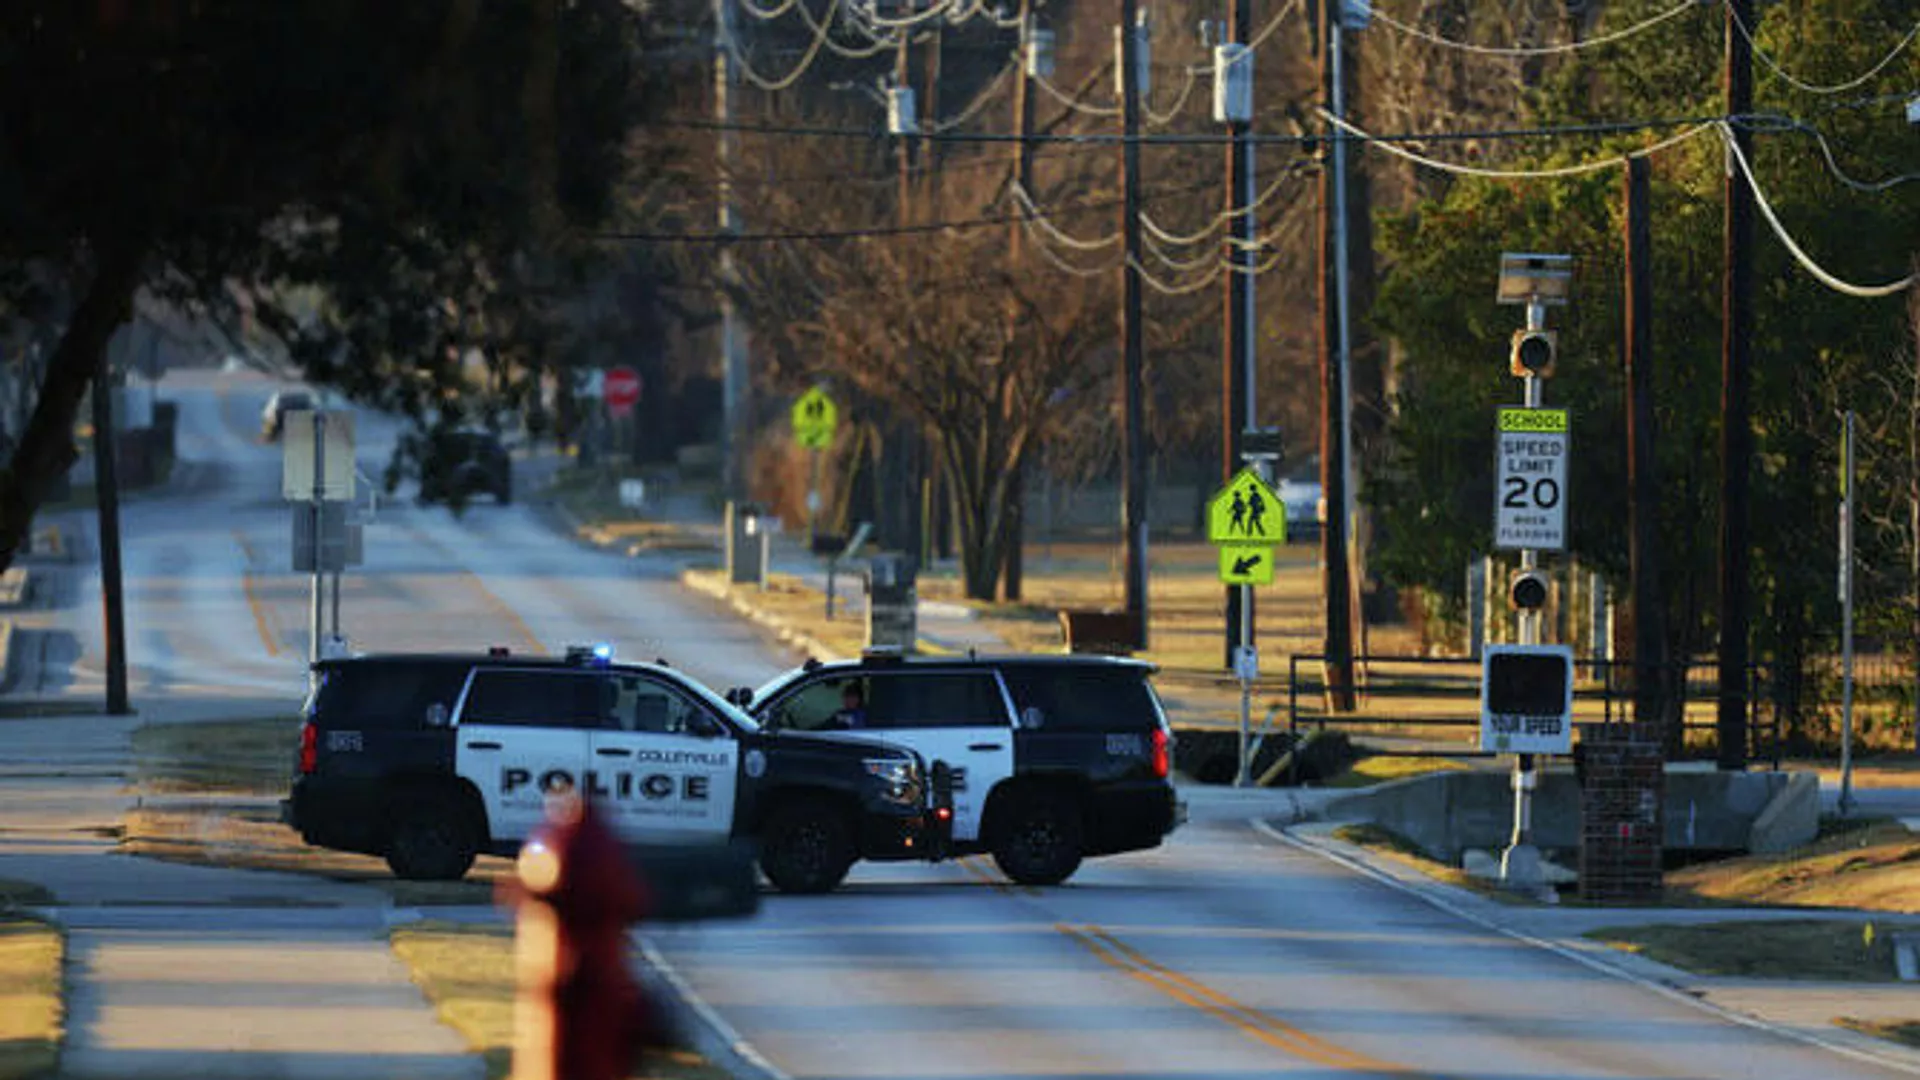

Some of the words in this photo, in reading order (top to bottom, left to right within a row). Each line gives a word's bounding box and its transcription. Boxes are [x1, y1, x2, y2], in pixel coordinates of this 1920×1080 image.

[1502, 412, 1567, 428] SCHOOL
[1503, 440, 1563, 456] SPEED
[1507, 459, 1555, 473] LIMIT
[1503, 477, 1560, 509] 20
[1490, 716, 1520, 734] YOUR
[1525, 717, 1563, 735] SPEED
[500, 767, 711, 801] POLICE
